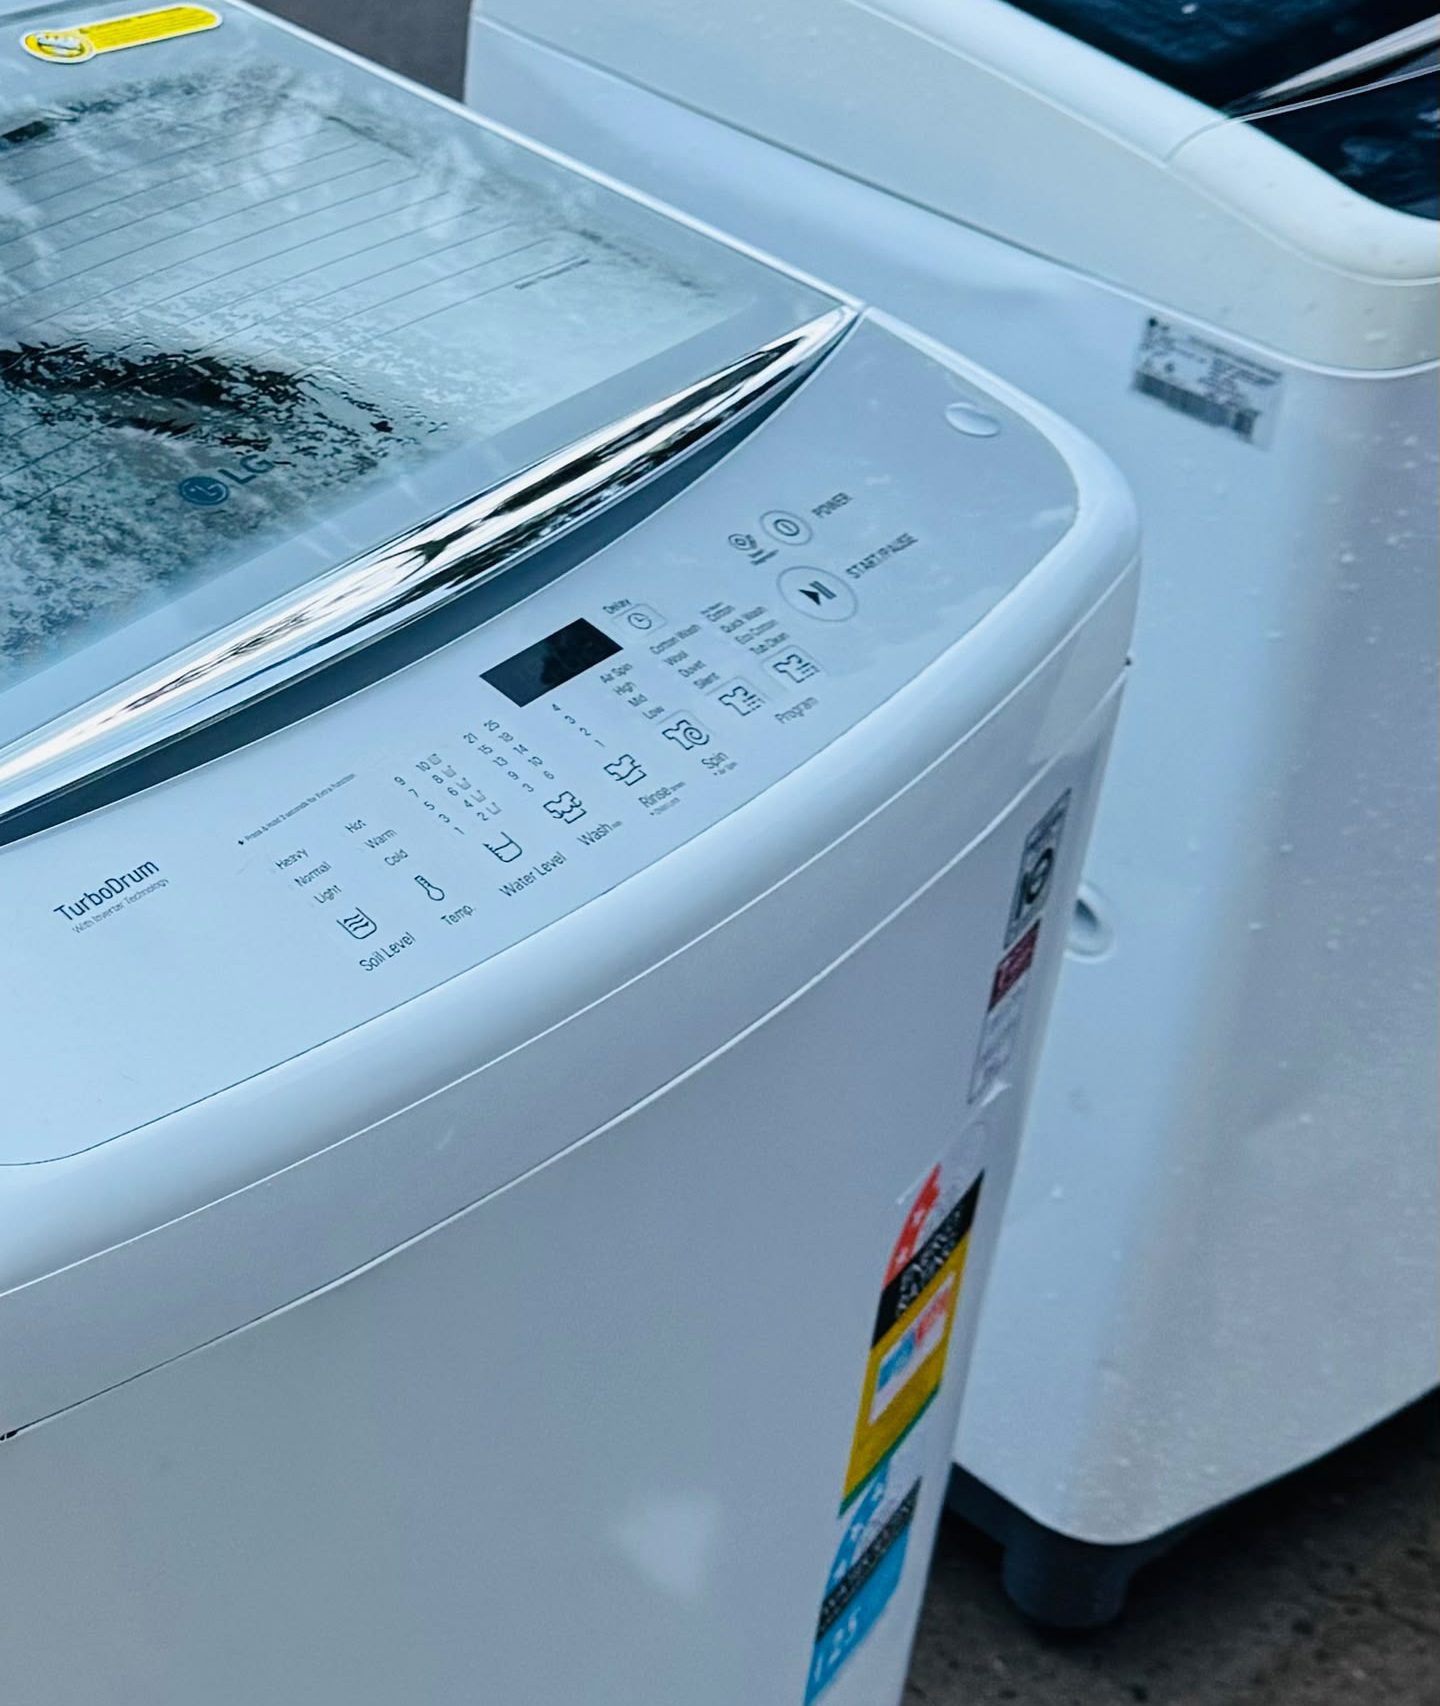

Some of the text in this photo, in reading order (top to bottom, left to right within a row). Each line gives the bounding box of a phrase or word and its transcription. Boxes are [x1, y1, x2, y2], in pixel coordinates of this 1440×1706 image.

[564, 715, 576, 724] 3
[774, 697, 819, 724] Program
[579, 727, 592, 736] 2
[513, 744, 528, 755] 14
[394, 761, 431, 786] 9 10
[507, 770, 520, 781] 9
[408, 774, 444, 798] 7 8
[522, 783, 534, 793] 3
[423, 787, 459, 811] 5 6
[638, 787, 672, 808] Rinse
[438, 799, 474, 823] 3 4
[477, 812, 490, 821] 2
[345, 819, 366, 833] Hot
[577, 823, 613, 846] Wash
[364, 829, 398, 849] Warm
[275, 848, 309, 870] Heavy
[384, 848, 409, 866] Cold
[294, 860, 332, 887] Normal
[498, 851, 567, 898] Water Level
[53, 860, 160, 921] TurboDrum
[314, 884, 342, 904] Light
[359, 931, 416, 972] Soil Level
